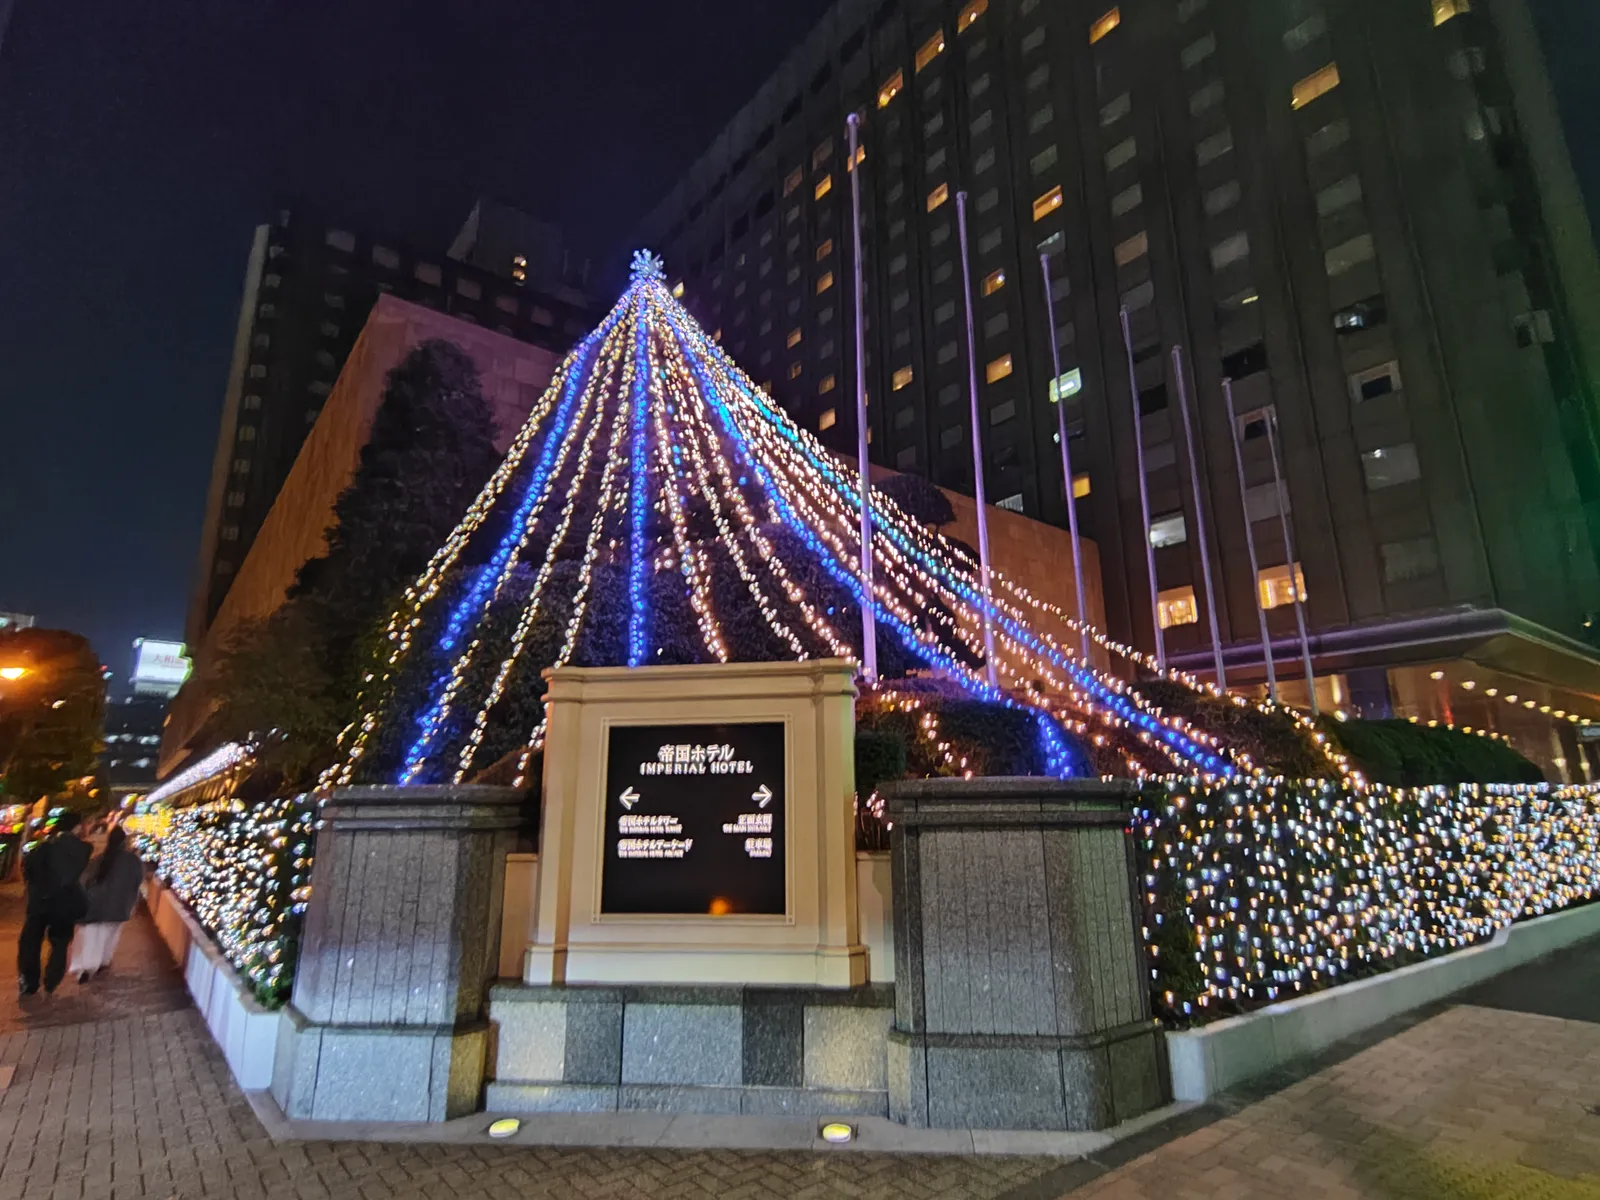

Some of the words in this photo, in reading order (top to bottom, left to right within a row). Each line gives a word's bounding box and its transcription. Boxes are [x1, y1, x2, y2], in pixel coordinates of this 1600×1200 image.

[658, 744, 735, 762] 帝国ホテル
[639, 762, 706, 775] IMPERIAL
[710, 761, 754, 774] HOTEL
